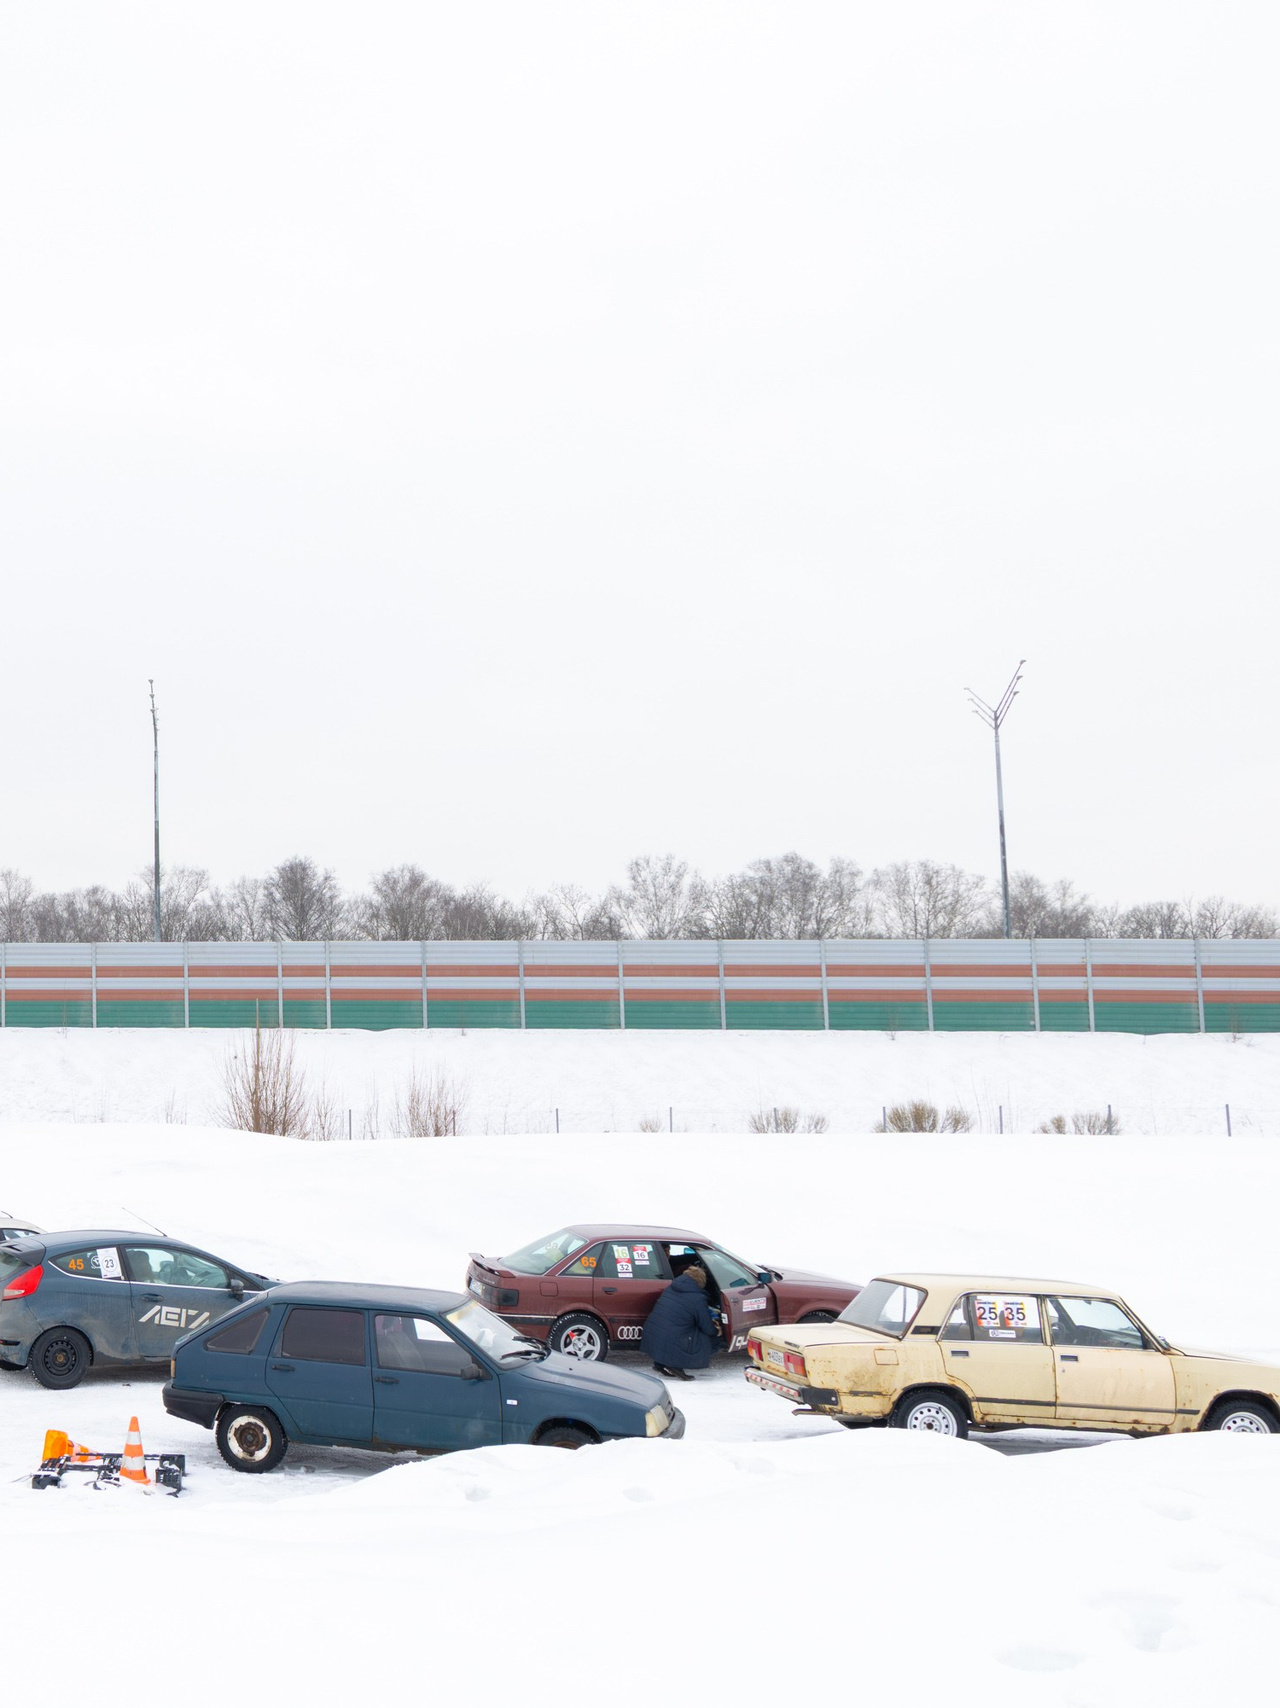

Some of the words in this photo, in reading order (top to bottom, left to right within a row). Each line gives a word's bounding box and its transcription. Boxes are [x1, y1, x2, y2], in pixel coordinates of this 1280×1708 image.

[616, 1248, 629, 1258] 16
[636, 1251, 646, 1259] 16
[68, 1258, 85, 1271] 45
[104, 1258, 115, 1269] 23
[580, 1256, 597, 1268] 65
[976, 1306, 998, 1321] 25
[1004, 1307, 1026, 1321] 35
